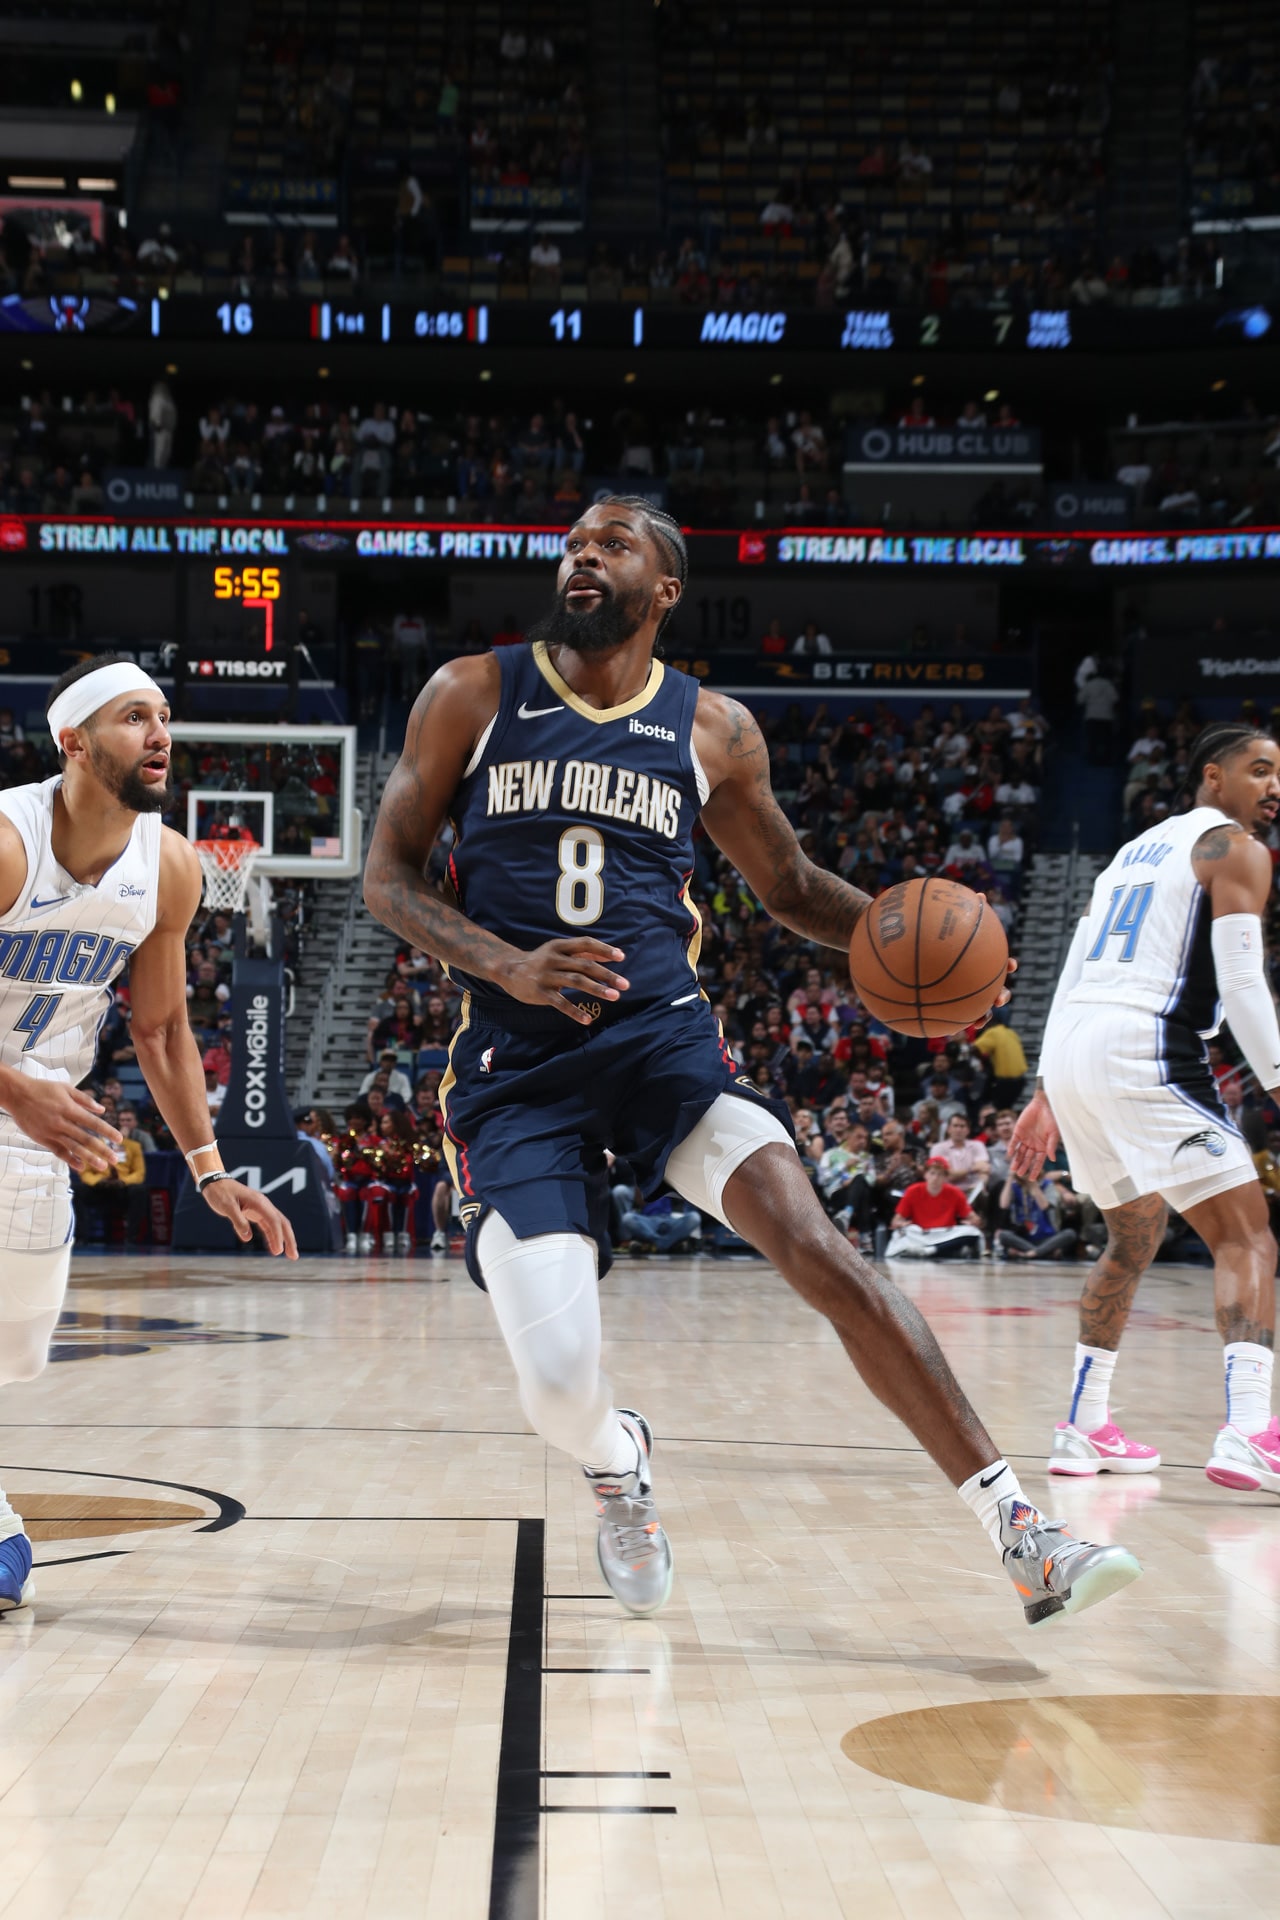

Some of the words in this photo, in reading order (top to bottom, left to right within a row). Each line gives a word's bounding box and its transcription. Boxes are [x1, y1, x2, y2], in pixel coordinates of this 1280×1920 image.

[217, 303, 252, 334] 16
[336, 311, 364, 333] 1st
[550, 309, 581, 340] 11
[700, 311, 787, 343] MAGIC
[920, 315, 940, 344] 2
[993, 315, 1012, 344] 7
[897, 434, 953, 455] HUB
[957, 434, 1029, 455] CLUB
[135, 482, 178, 499] HUB
[1082, 497, 1126, 514] HUB
[40, 524, 127, 551] STREAM
[131, 526, 170, 552] ALL
[221, 528, 288, 554] LOCAL
[357, 531, 435, 557] GAMES.
[440, 532, 523, 558] PRETTY
[778, 536, 866, 562] STREAM
[868, 537, 908, 563] ALL
[911, 537, 955, 563] THE
[957, 538, 1026, 564] LOCAL
[1175, 533, 1264, 562] PRETTY
[214, 567, 281, 599] 5:55
[242, 598, 274, 652] 7
[697, 596, 750, 640] 119
[214, 660, 287, 677] TISSOT
[813, 663, 985, 680] BETRIVERS
[629, 718, 676, 742] ibotta
[487, 760, 557, 816] NEW
[560, 760, 681, 839] ORLEANS
[556, 825, 604, 926] 8
[1086, 881, 1155, 962] 14
[0, 930, 137, 983] MAGIC
[13, 993, 64, 1052] 4
